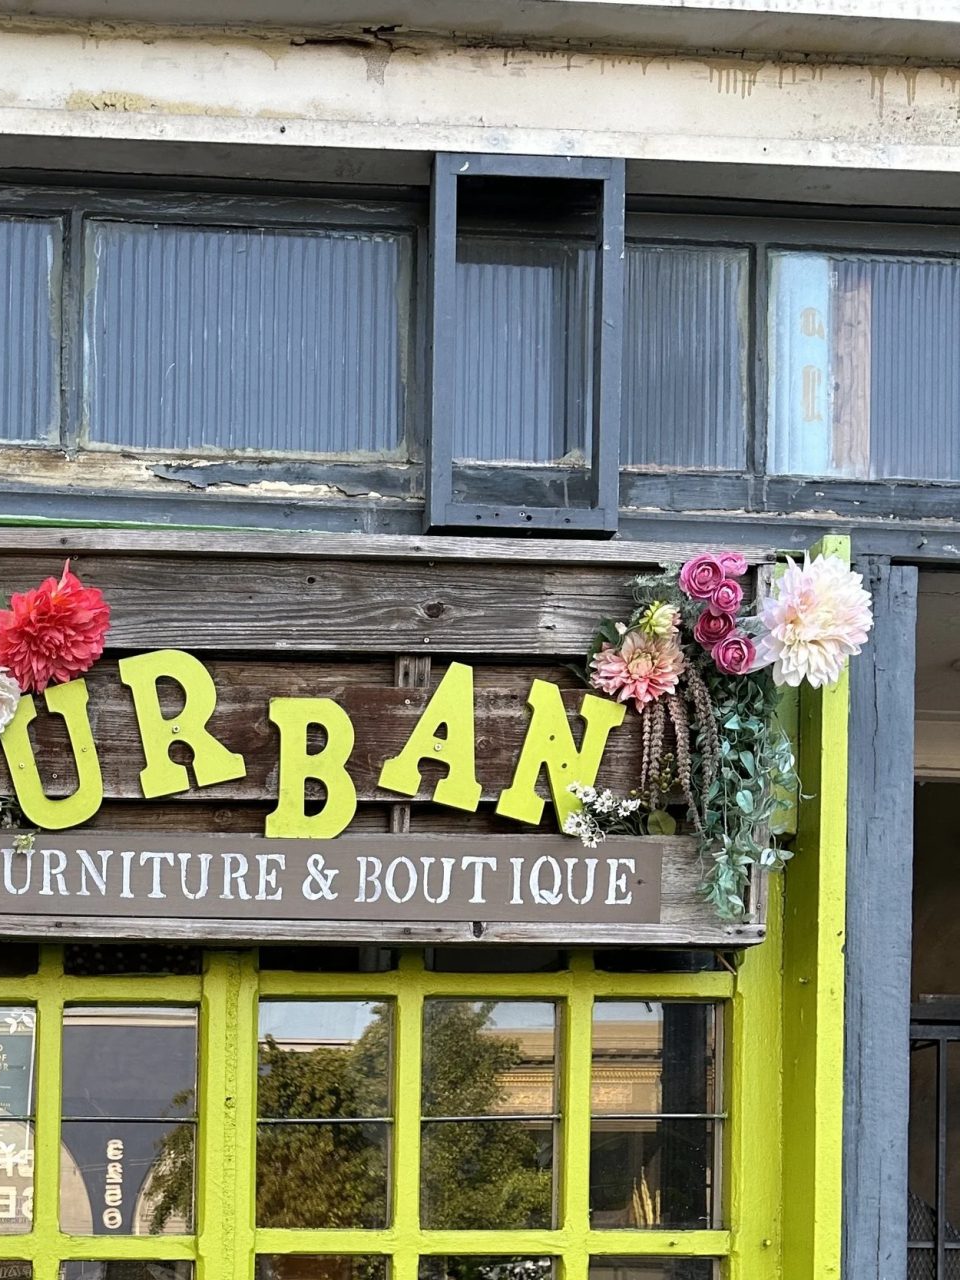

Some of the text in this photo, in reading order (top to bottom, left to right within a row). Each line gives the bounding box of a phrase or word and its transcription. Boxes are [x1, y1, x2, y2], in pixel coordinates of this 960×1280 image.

[0, 649, 628, 840] URBAN
[301, 852, 340, 901] &
[353, 854, 634, 906] BOUTIQUE
